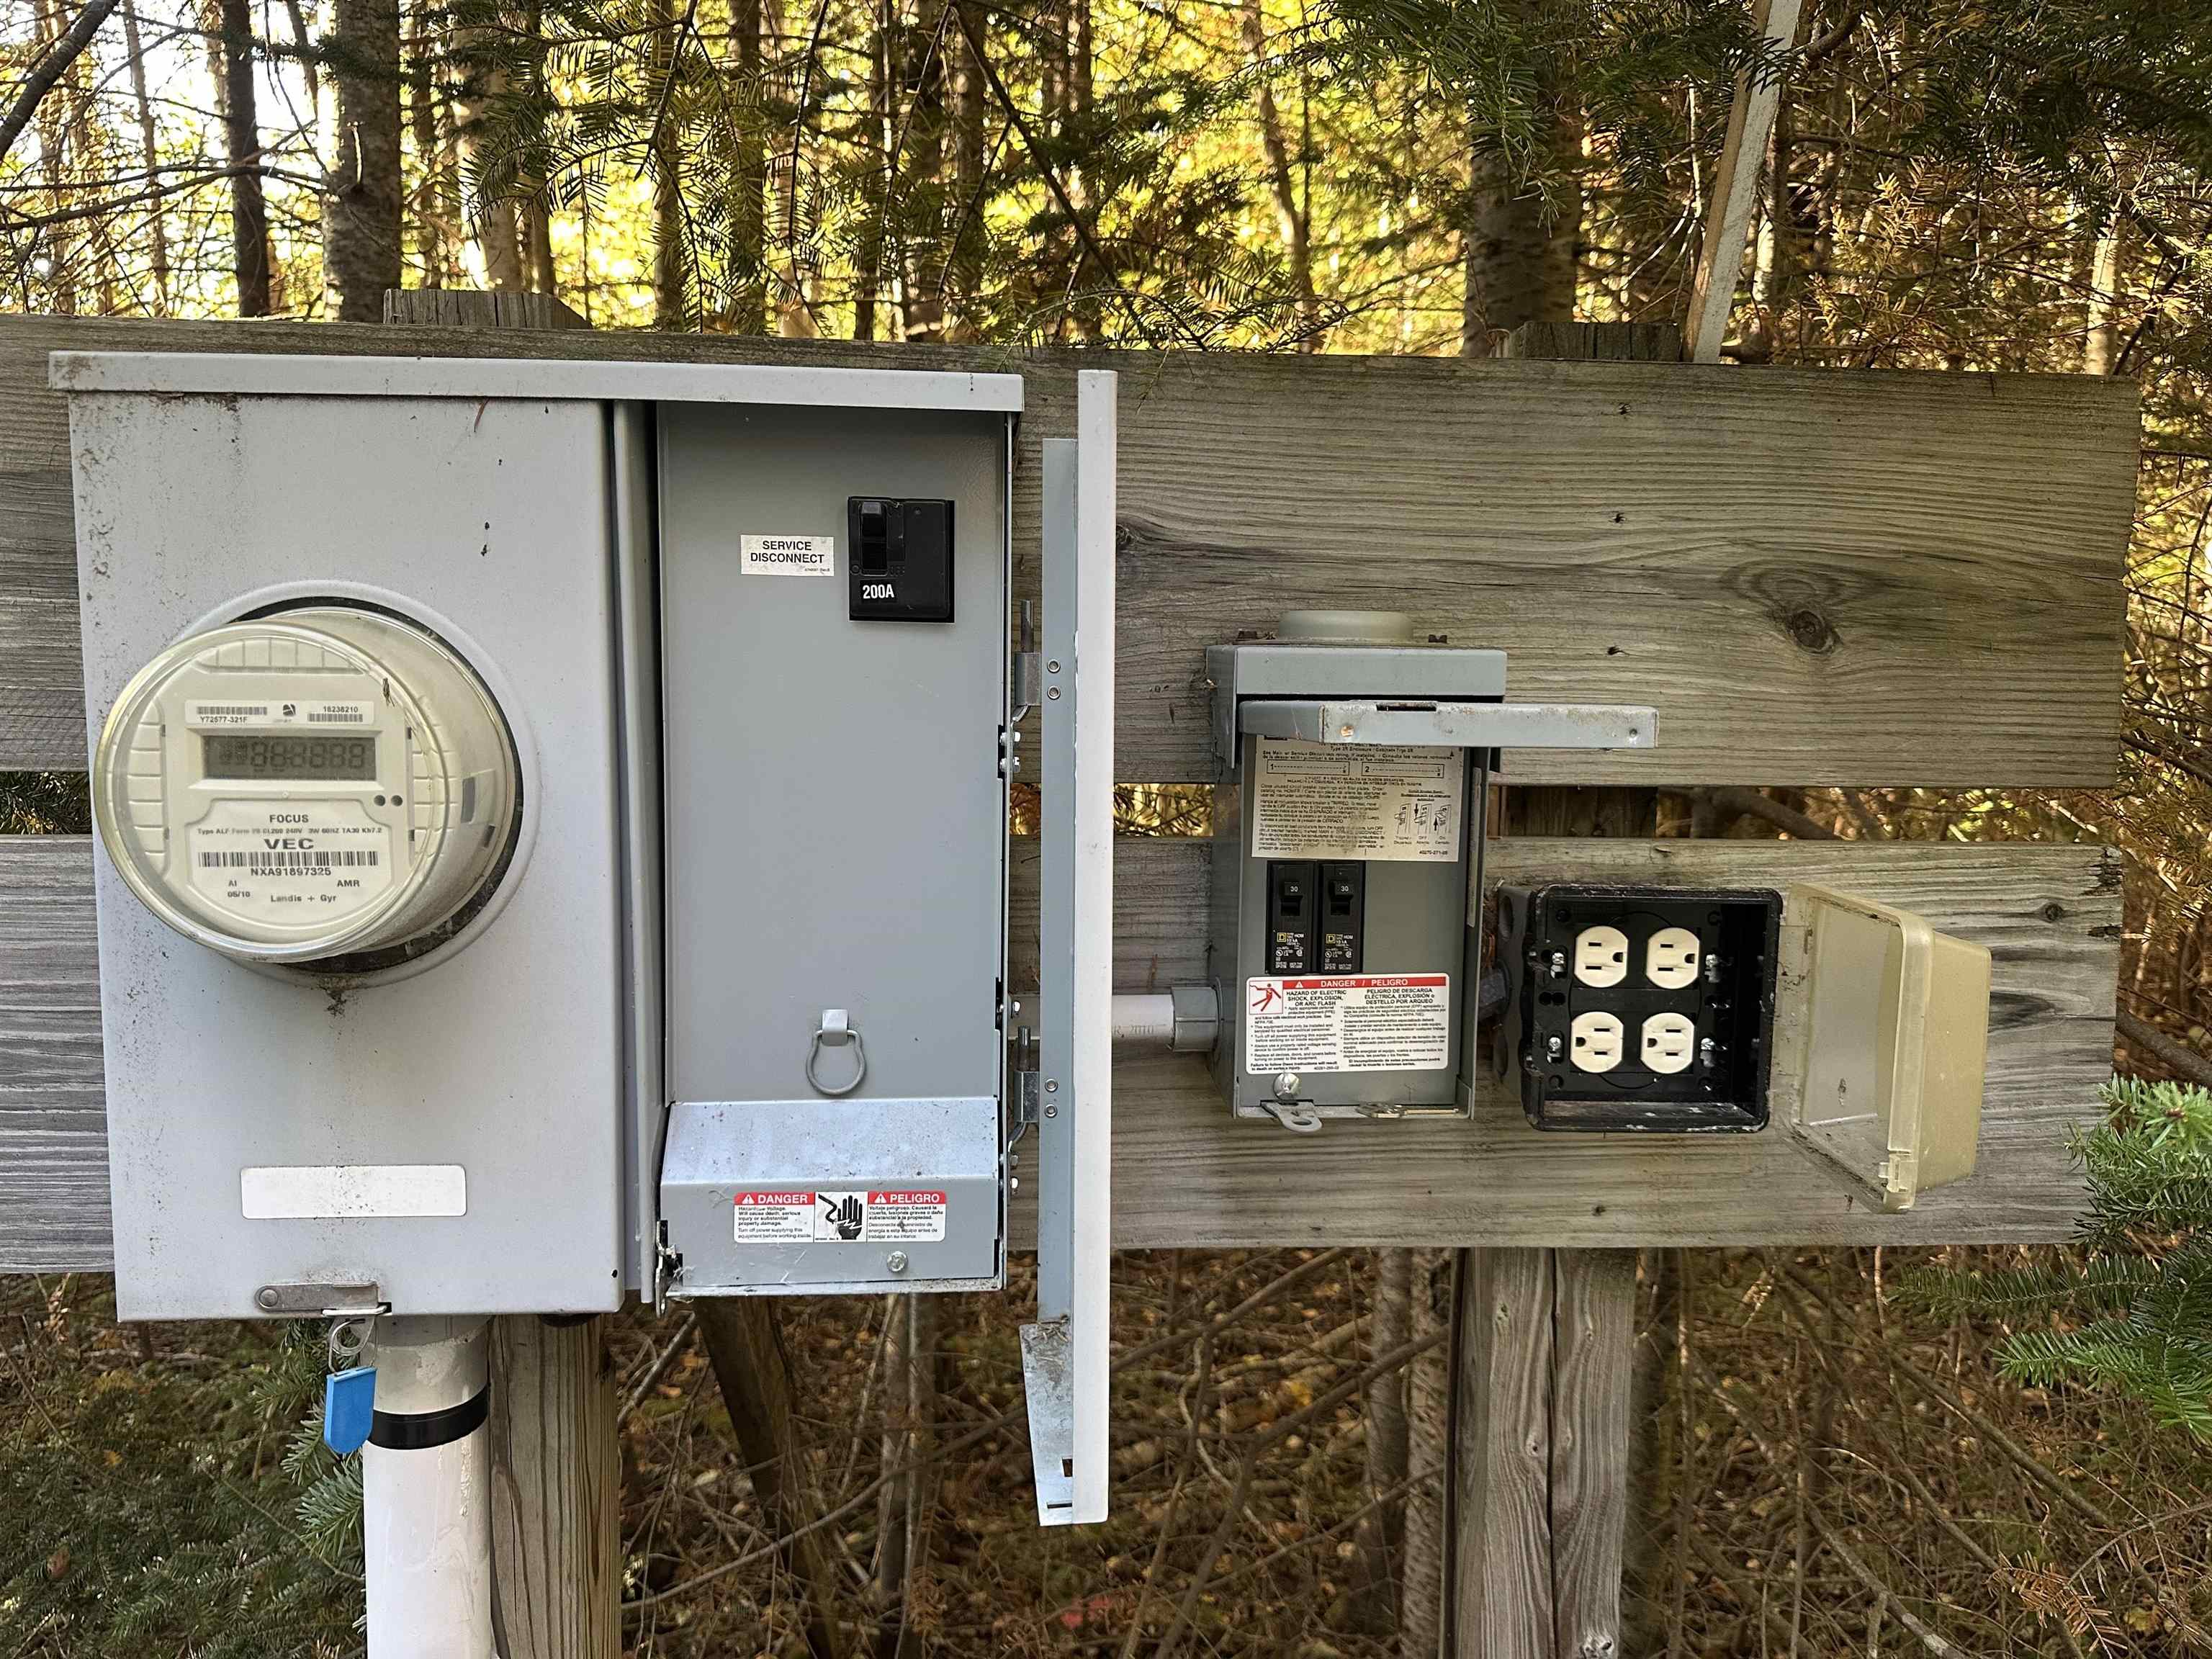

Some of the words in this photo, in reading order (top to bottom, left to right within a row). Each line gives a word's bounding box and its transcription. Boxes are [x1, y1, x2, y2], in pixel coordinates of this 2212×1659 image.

[763, 540, 811, 551] SERVICE
[750, 552, 824, 563] DISCONNECT
[863, 584, 895, 599] 200A
[269, 814, 309, 823] FOCUS
[264, 838, 314, 850] VEC
[251, 867, 331, 876] NXA91897325
[320, 894, 337, 903] Gyr
[757, 1195, 808, 1204] DANGER
[890, 1193, 940, 1203] PELIGRO
